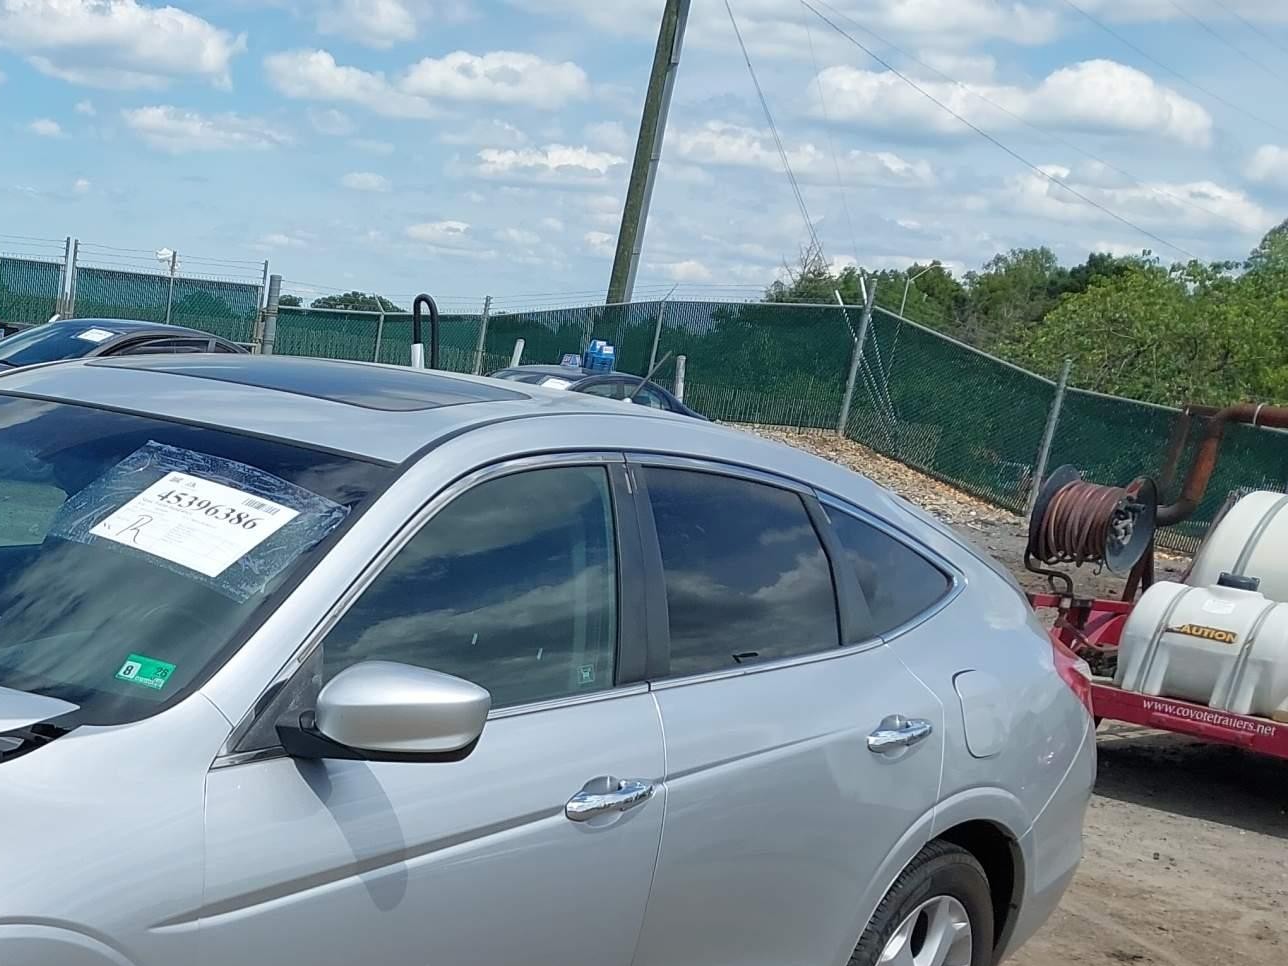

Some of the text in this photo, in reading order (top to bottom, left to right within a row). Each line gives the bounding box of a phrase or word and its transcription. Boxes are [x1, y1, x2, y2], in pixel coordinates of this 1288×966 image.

[157, 489, 265, 530] 45396386
[122, 664, 169, 678] 8 26
